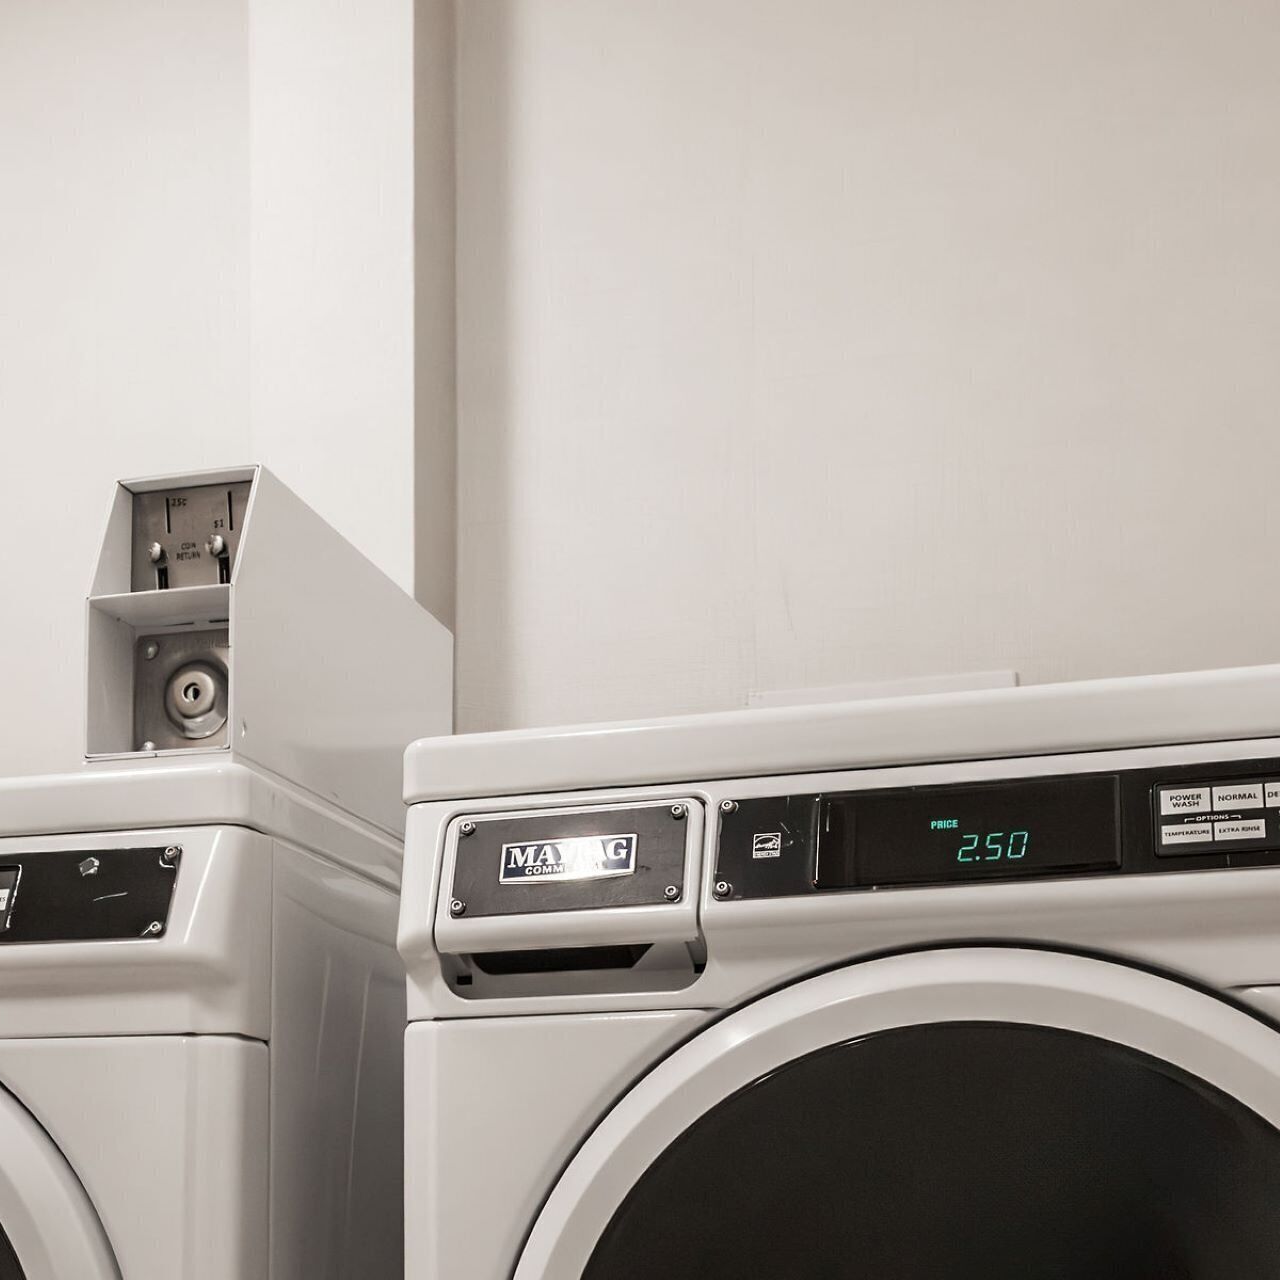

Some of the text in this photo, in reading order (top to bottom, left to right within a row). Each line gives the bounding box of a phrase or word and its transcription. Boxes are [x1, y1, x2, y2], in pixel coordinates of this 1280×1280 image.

[181, 542, 196, 551] COIN
[176, 551, 200, 561] RETURN
[1169, 793, 1202, 802] POWER
[1218, 793, 1258, 802] NORMAL
[1196, 814, 1229, 822] OPTIONS
[931, 819, 959, 829] PRICE
[1164, 829, 1210, 837] TEMPERATURE
[957, 831, 1028, 862] 2.50
[507, 838, 628, 868] MAYAG
